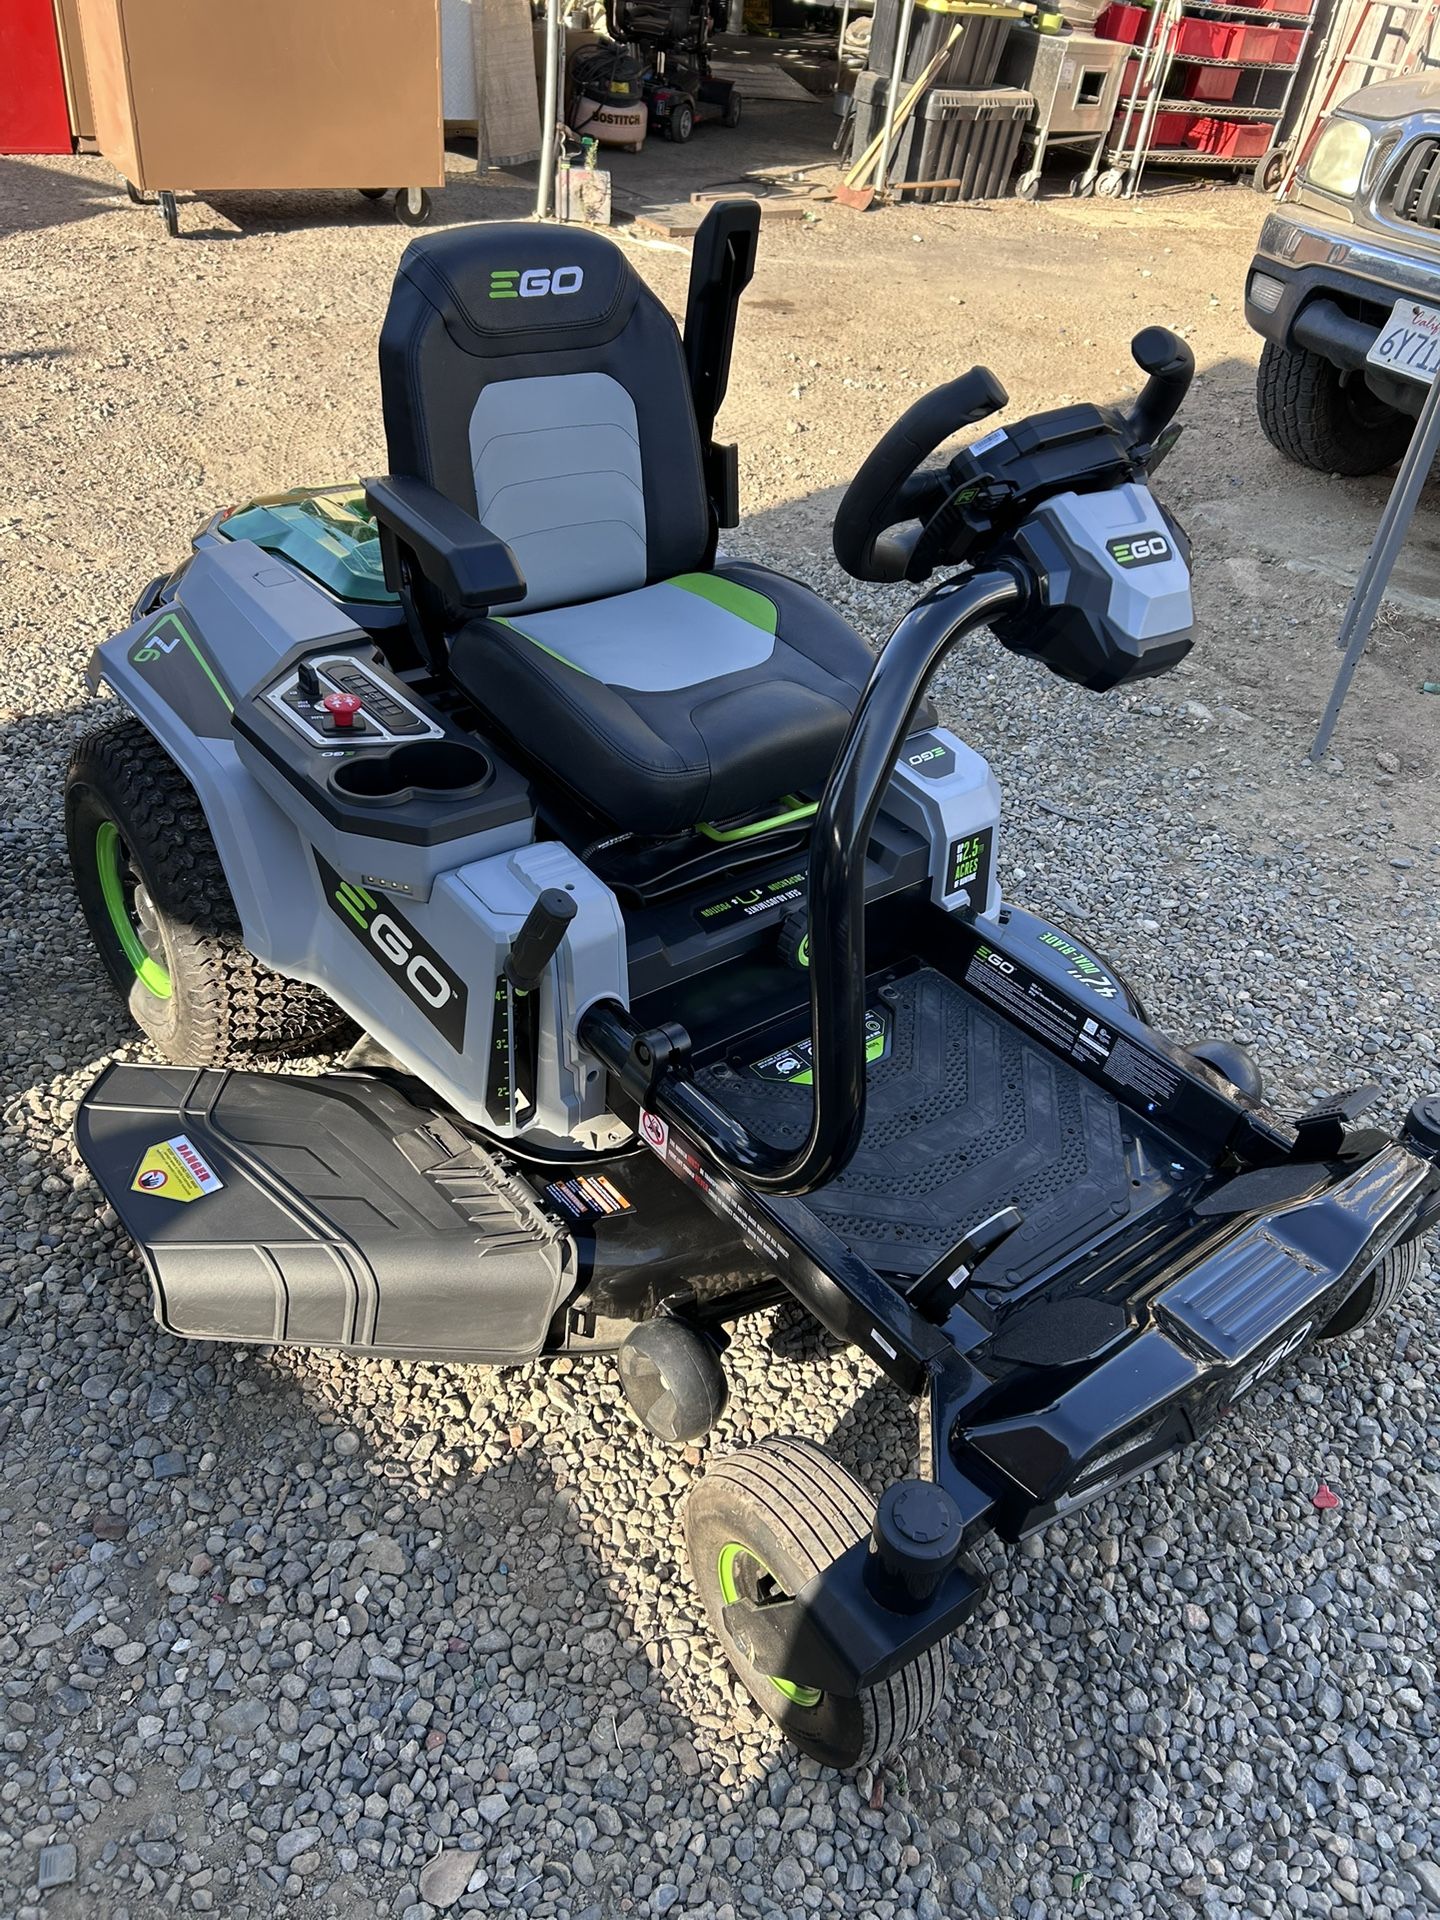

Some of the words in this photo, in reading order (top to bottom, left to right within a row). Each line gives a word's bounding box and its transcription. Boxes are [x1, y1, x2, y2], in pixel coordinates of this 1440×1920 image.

[592, 112, 640, 125] BOSTITCH
[176, 144, 211, 182] DANGER
[489, 266, 584, 298] EGO
[1113, 536, 1168, 563] EGO
[134, 636, 180, 662] Z6
[909, 746, 945, 766] EGO
[954, 858, 979, 879] ACRES
[744, 894, 787, 915] ADJUSTMENTS
[786, 888, 802, 899] SEAT
[701, 902, 732, 917] POSITION
[335, 881, 451, 1009] EGO
[1039, 931, 1101, 974] DUAL-BLADE
[976, 945, 1015, 974] EGO
[1229, 1321, 1313, 1403] EGO
